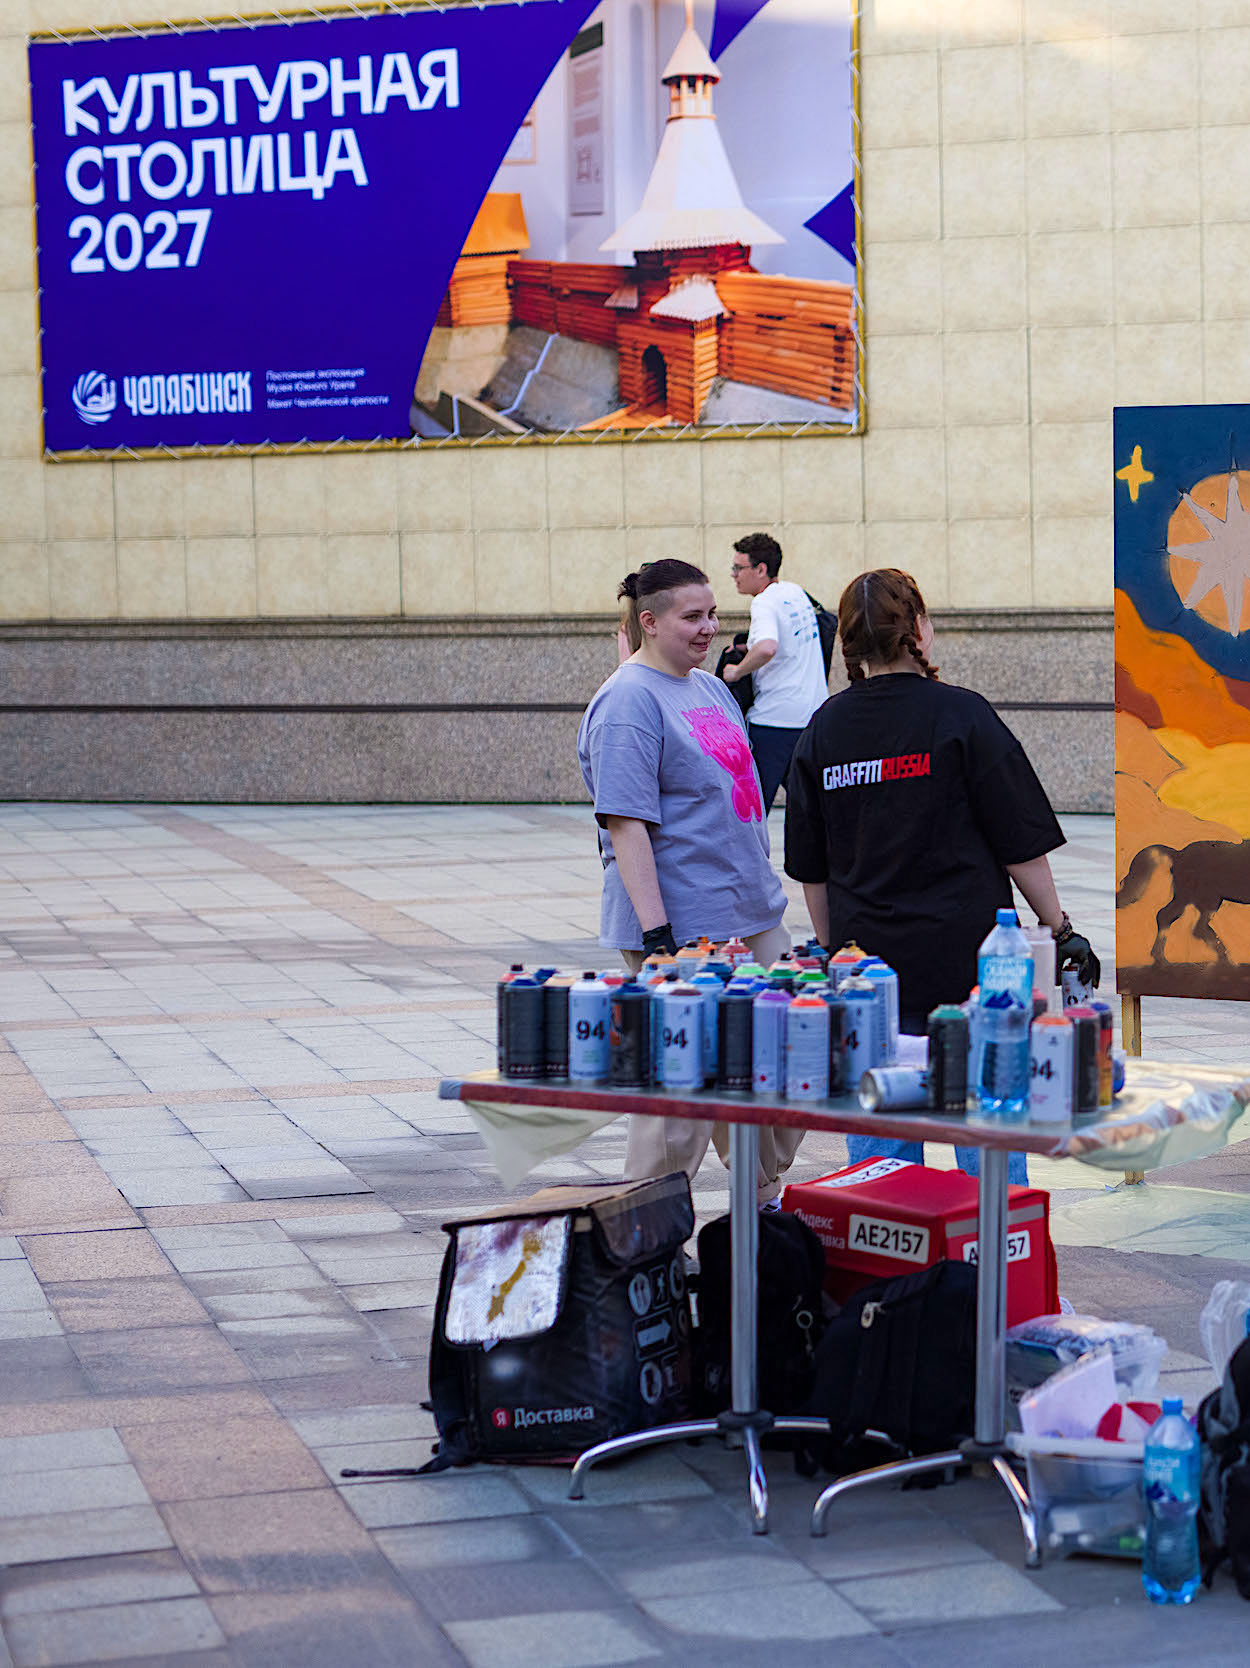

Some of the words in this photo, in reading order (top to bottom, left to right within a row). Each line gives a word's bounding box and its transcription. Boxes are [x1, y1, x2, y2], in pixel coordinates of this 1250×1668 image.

[62, 48, 460, 136] КУЛЬТУРНАЯ
[64, 127, 369, 205] СТОЛИЦА
[67, 207, 213, 274] 2027
[576, 1020, 605, 1041] 94
[661, 1027, 688, 1049] 94
[854, 1222, 924, 1255] AE2157
[514, 1406, 595, 1429] Доставка
